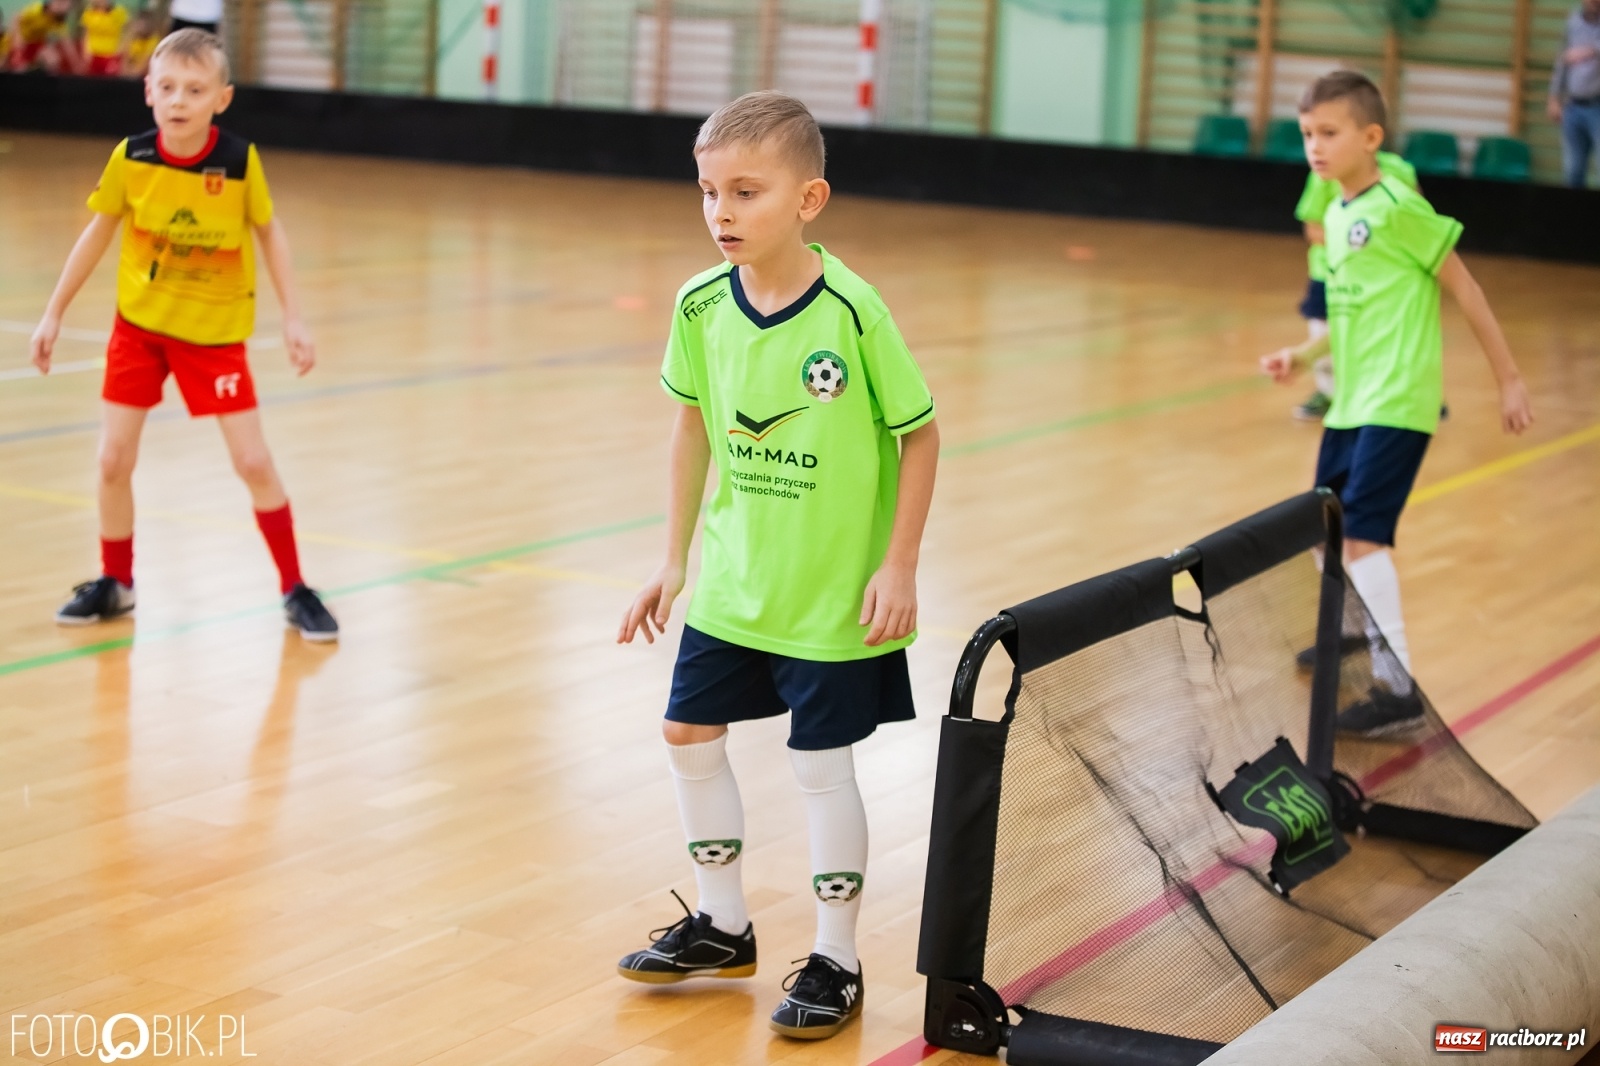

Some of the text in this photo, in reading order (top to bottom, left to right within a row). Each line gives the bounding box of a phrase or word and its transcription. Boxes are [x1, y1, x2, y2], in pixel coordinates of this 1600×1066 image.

[727, 436, 818, 469] AM-MAD
[774, 475, 817, 491] przyczep
[739, 484, 801, 500] samochodów
